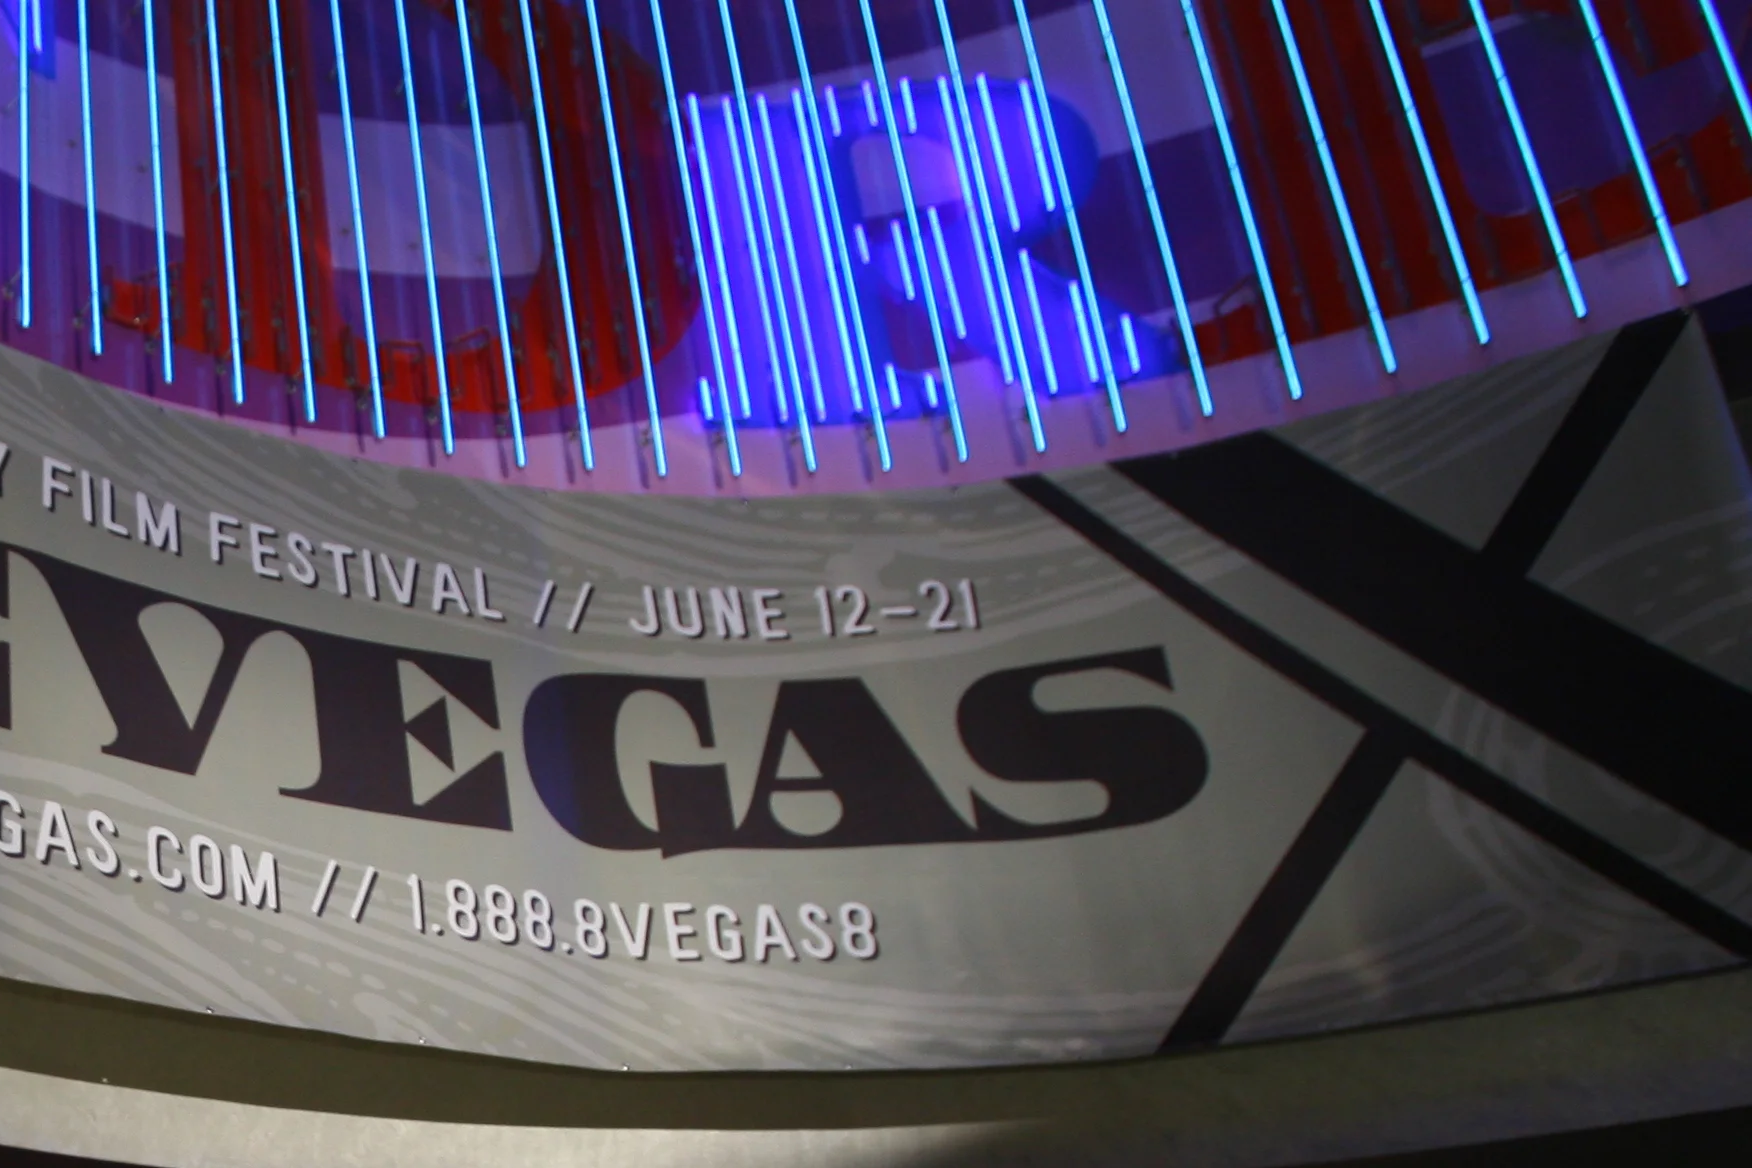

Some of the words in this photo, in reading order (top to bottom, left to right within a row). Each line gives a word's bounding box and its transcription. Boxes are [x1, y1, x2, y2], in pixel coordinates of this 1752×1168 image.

[42, 456, 182, 554] FILM
[208, 511, 506, 622] FESTIVAL
[629, 583, 790, 641] JUNE
[406, 872, 880, 962] 1.888.8VEGAS8
